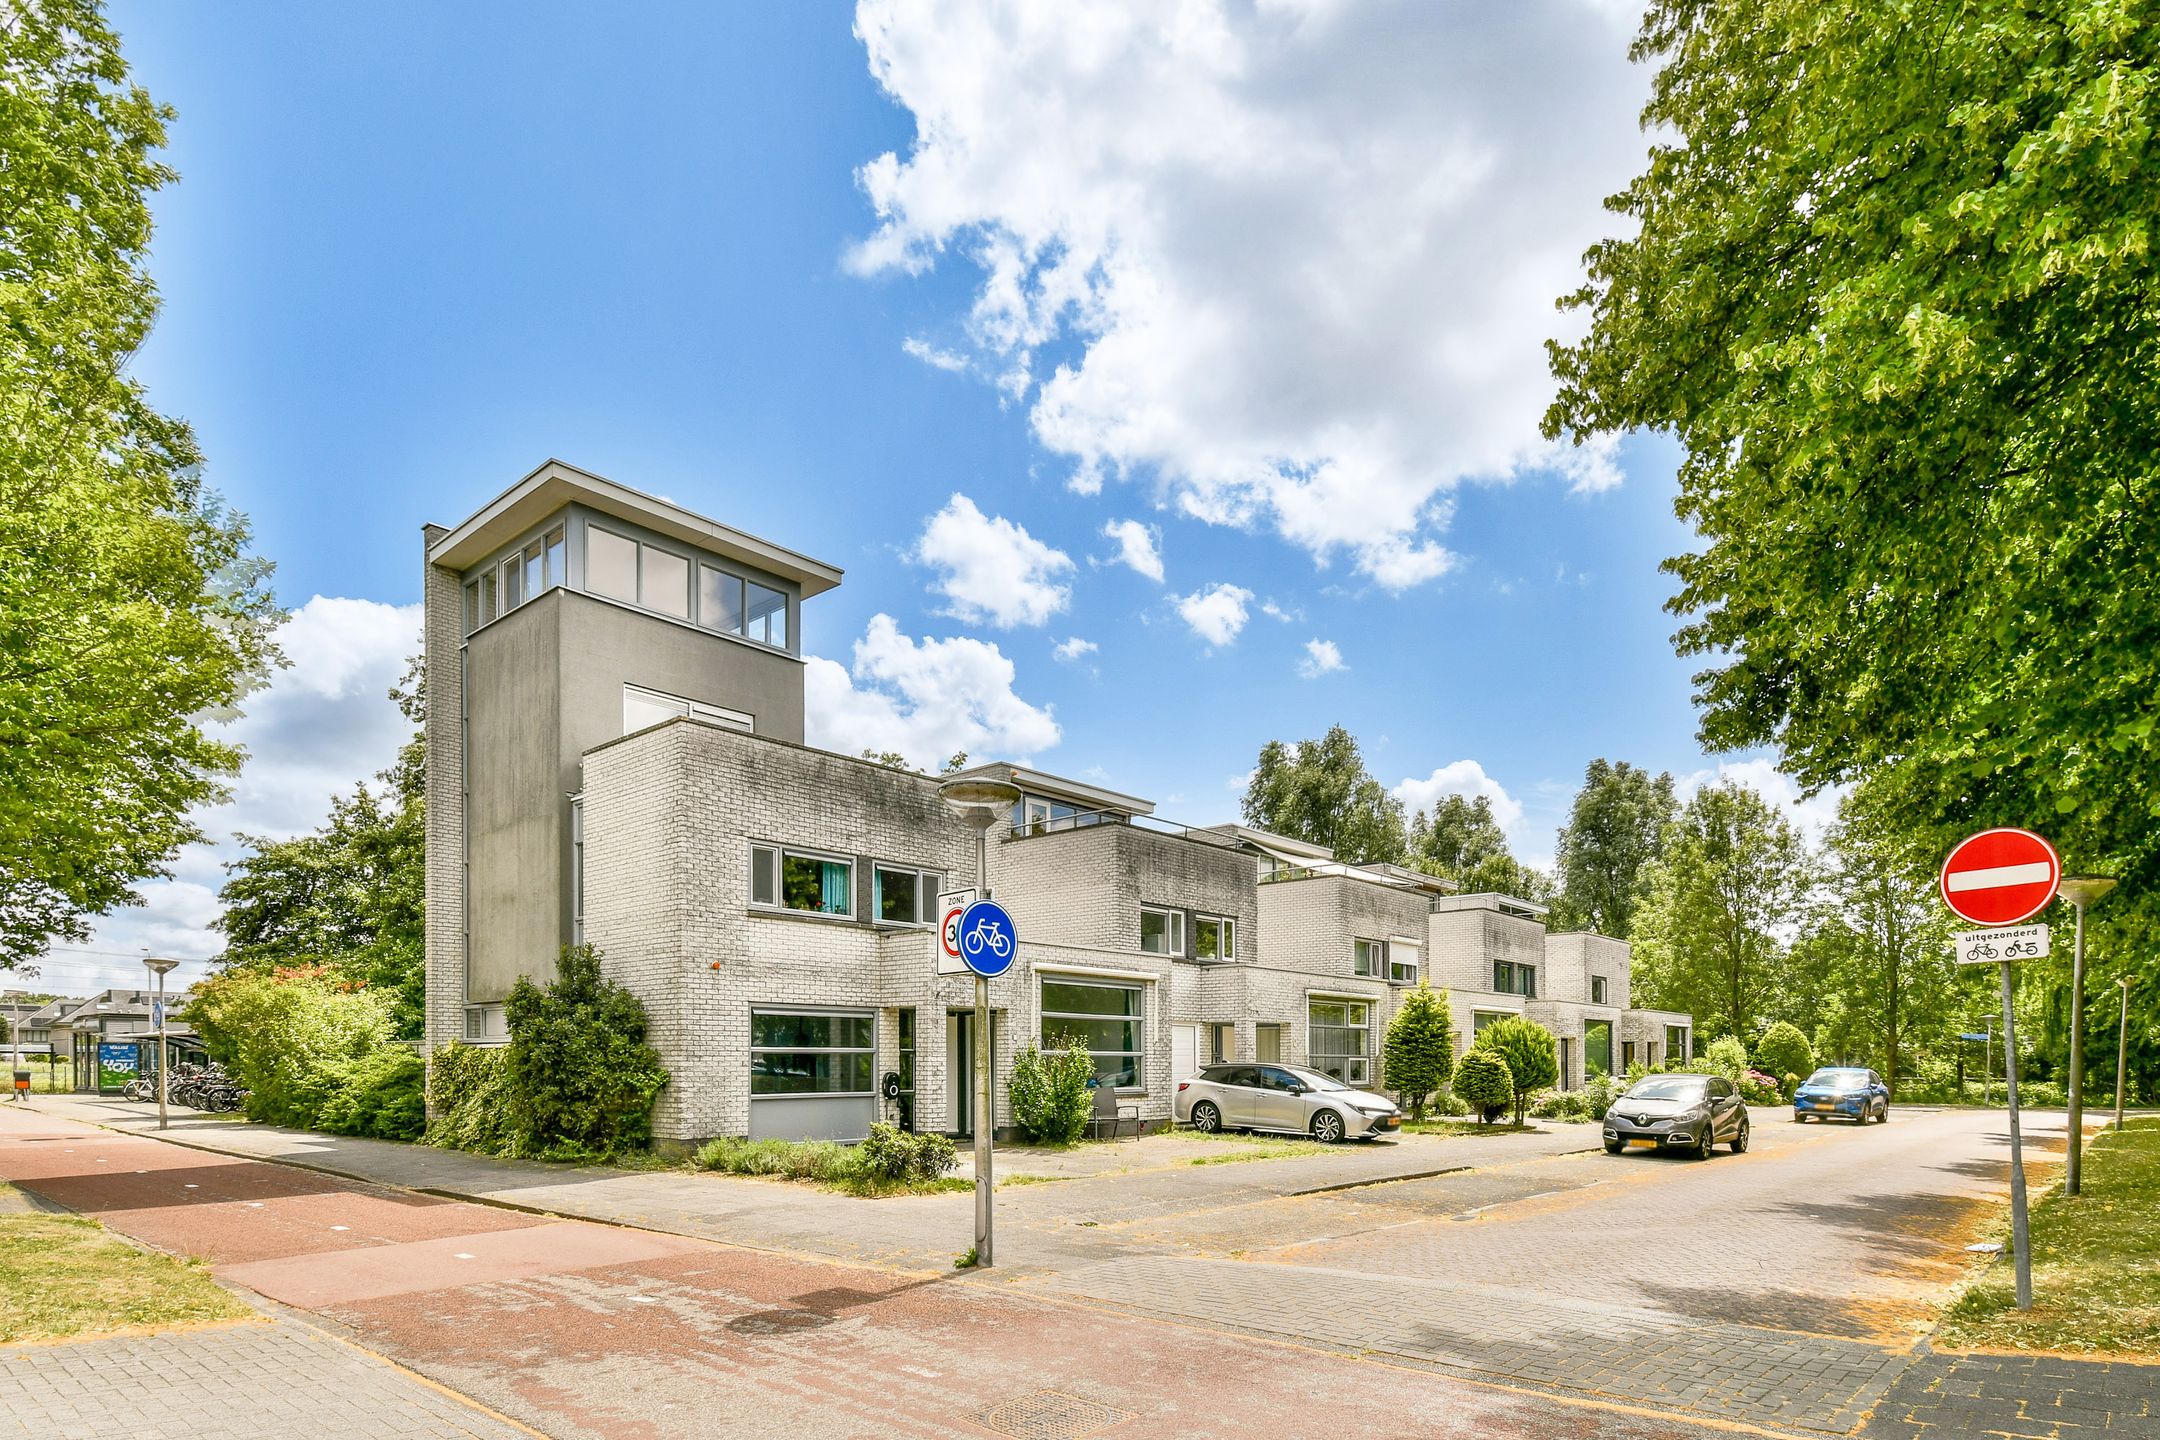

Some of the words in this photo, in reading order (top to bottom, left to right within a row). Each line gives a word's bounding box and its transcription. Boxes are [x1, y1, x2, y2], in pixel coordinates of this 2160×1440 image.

[948, 896, 965, 905] ZONE
[947, 924, 956, 942] 3
[1965, 928, 2038, 942] uitgezonderd
